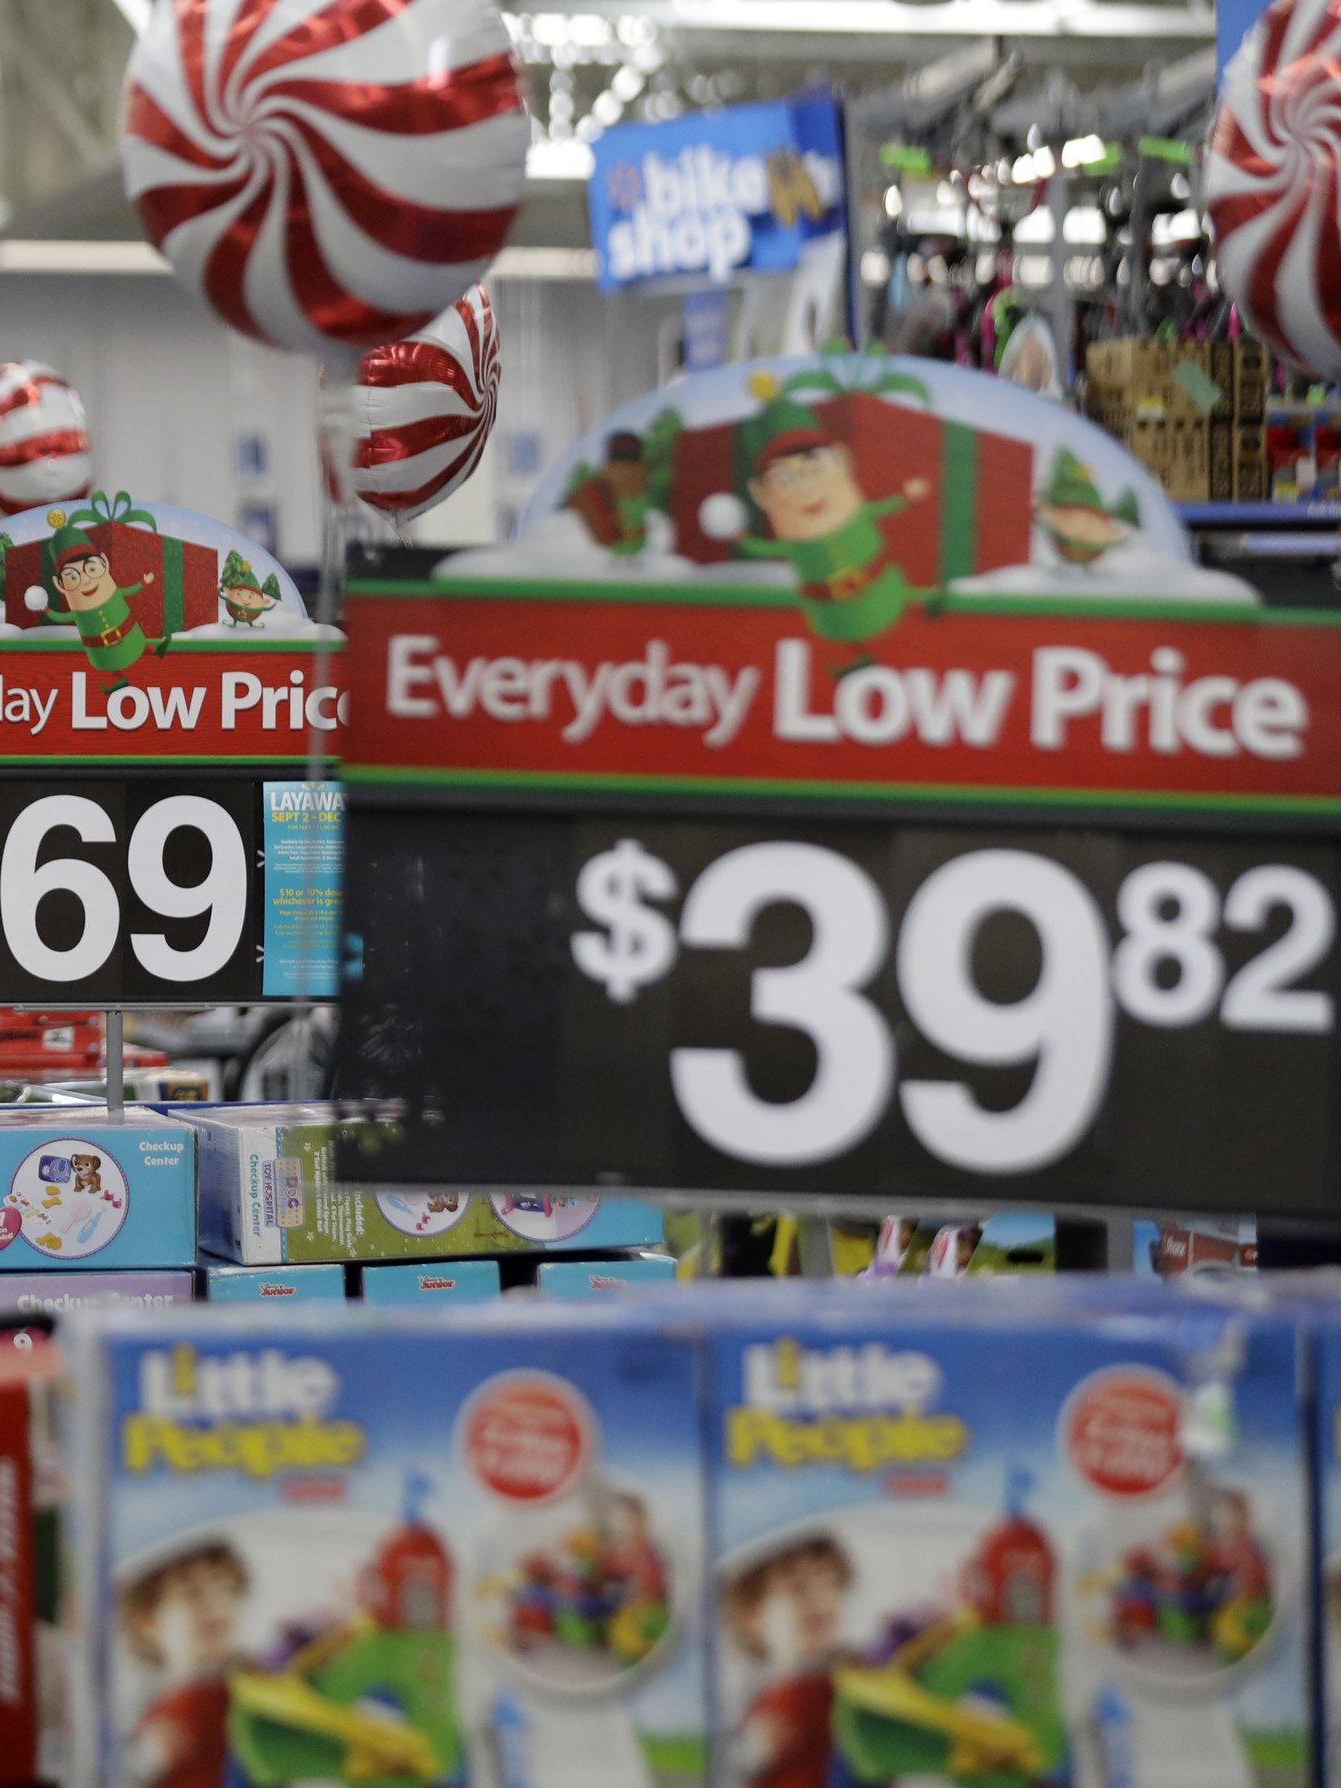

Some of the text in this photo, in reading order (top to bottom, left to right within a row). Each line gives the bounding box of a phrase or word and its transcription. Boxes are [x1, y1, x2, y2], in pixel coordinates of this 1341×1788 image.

[642, 146, 768, 216] bike
[606, 203, 752, 285] shop
[71, 671, 207, 731] Low
[386, 633, 1310, 758] Everyday Low Price
[270, 792, 347, 811] LAYAWA
[271, 812, 300, 822] SEPT
[302, 812, 310, 822] 2
[318, 812, 342, 822] DEC
[272, 897, 315, 905] whichever
[316, 897, 324, 905] is
[279, 888, 294, 896] $10
[138, 1141, 184, 1154] Checkup
[144, 1155, 179, 1166] Center
[264, 1163, 272, 1180] TOY
[249, 1154, 260, 1237] Checkup Center
[17, 1293, 102, 1314] Checku
[13, 1332, 33, 1355] 9
[139, 1346, 340, 1416] Little
[743, 1338, 942, 1408] Little
[124, 1412, 366, 1480] People
[727, 1405, 969, 1472] People
